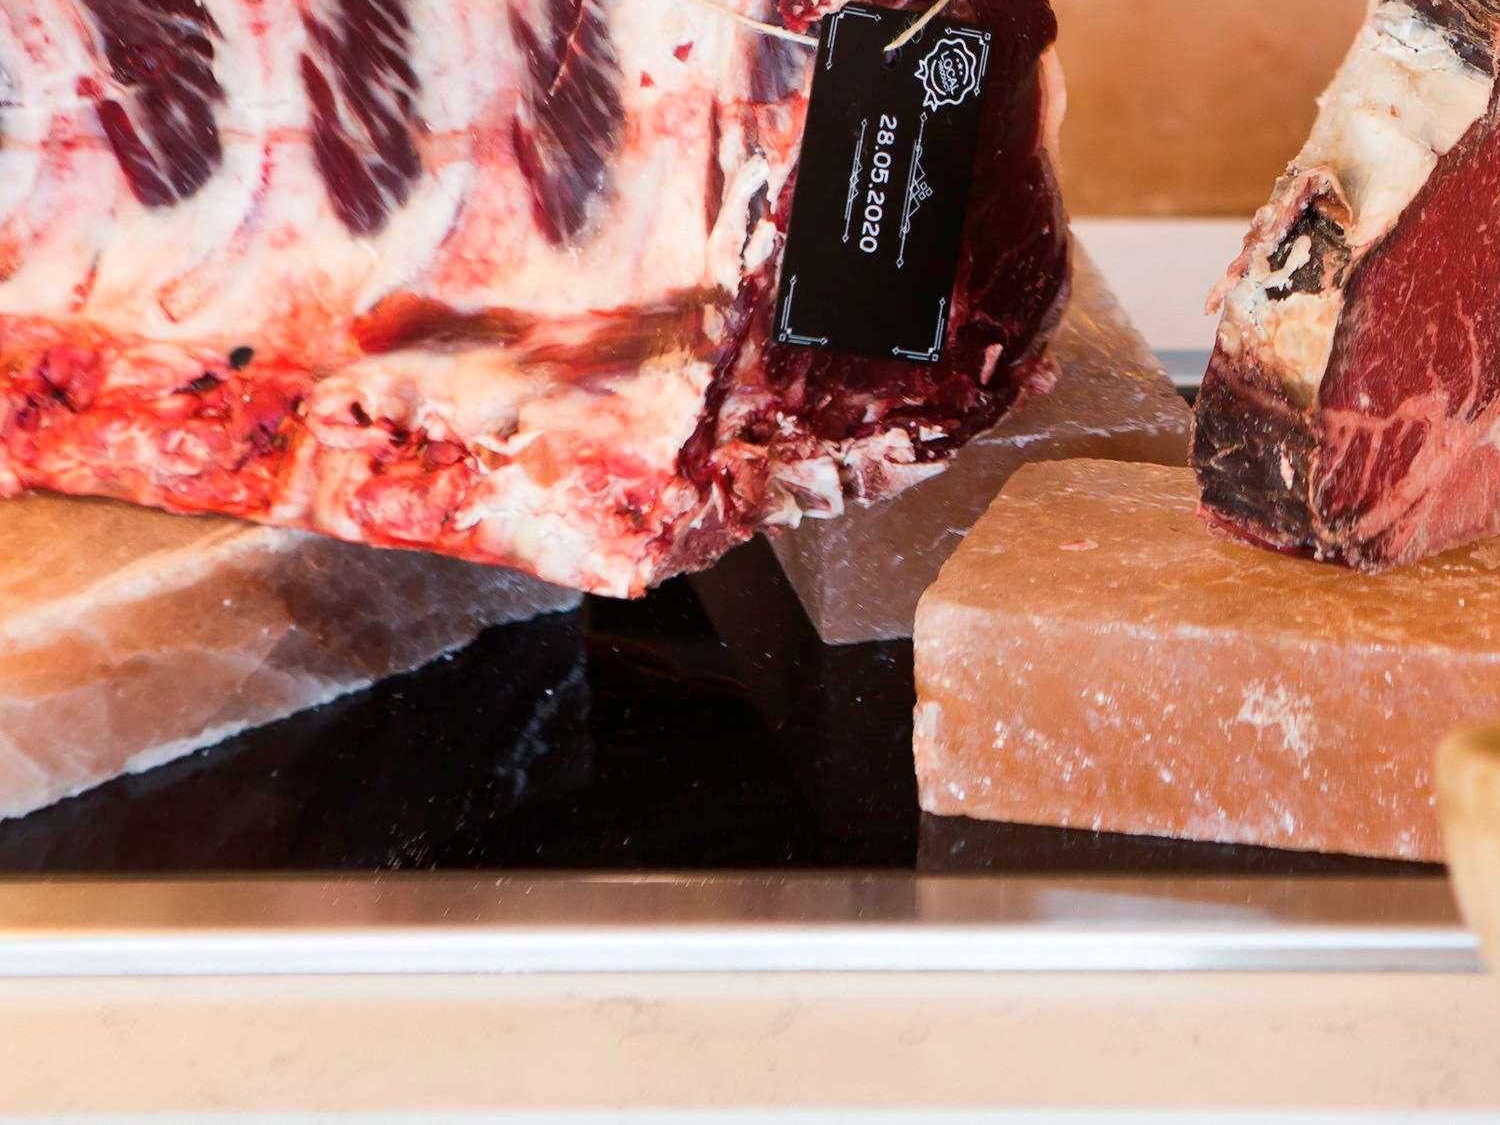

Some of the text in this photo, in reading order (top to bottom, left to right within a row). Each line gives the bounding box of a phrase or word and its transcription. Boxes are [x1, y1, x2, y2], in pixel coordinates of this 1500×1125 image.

[938, 59, 952, 92] PRODUCT
[941, 51, 959, 95] LOCAL
[859, 114, 897, 253] 28.05.2020
